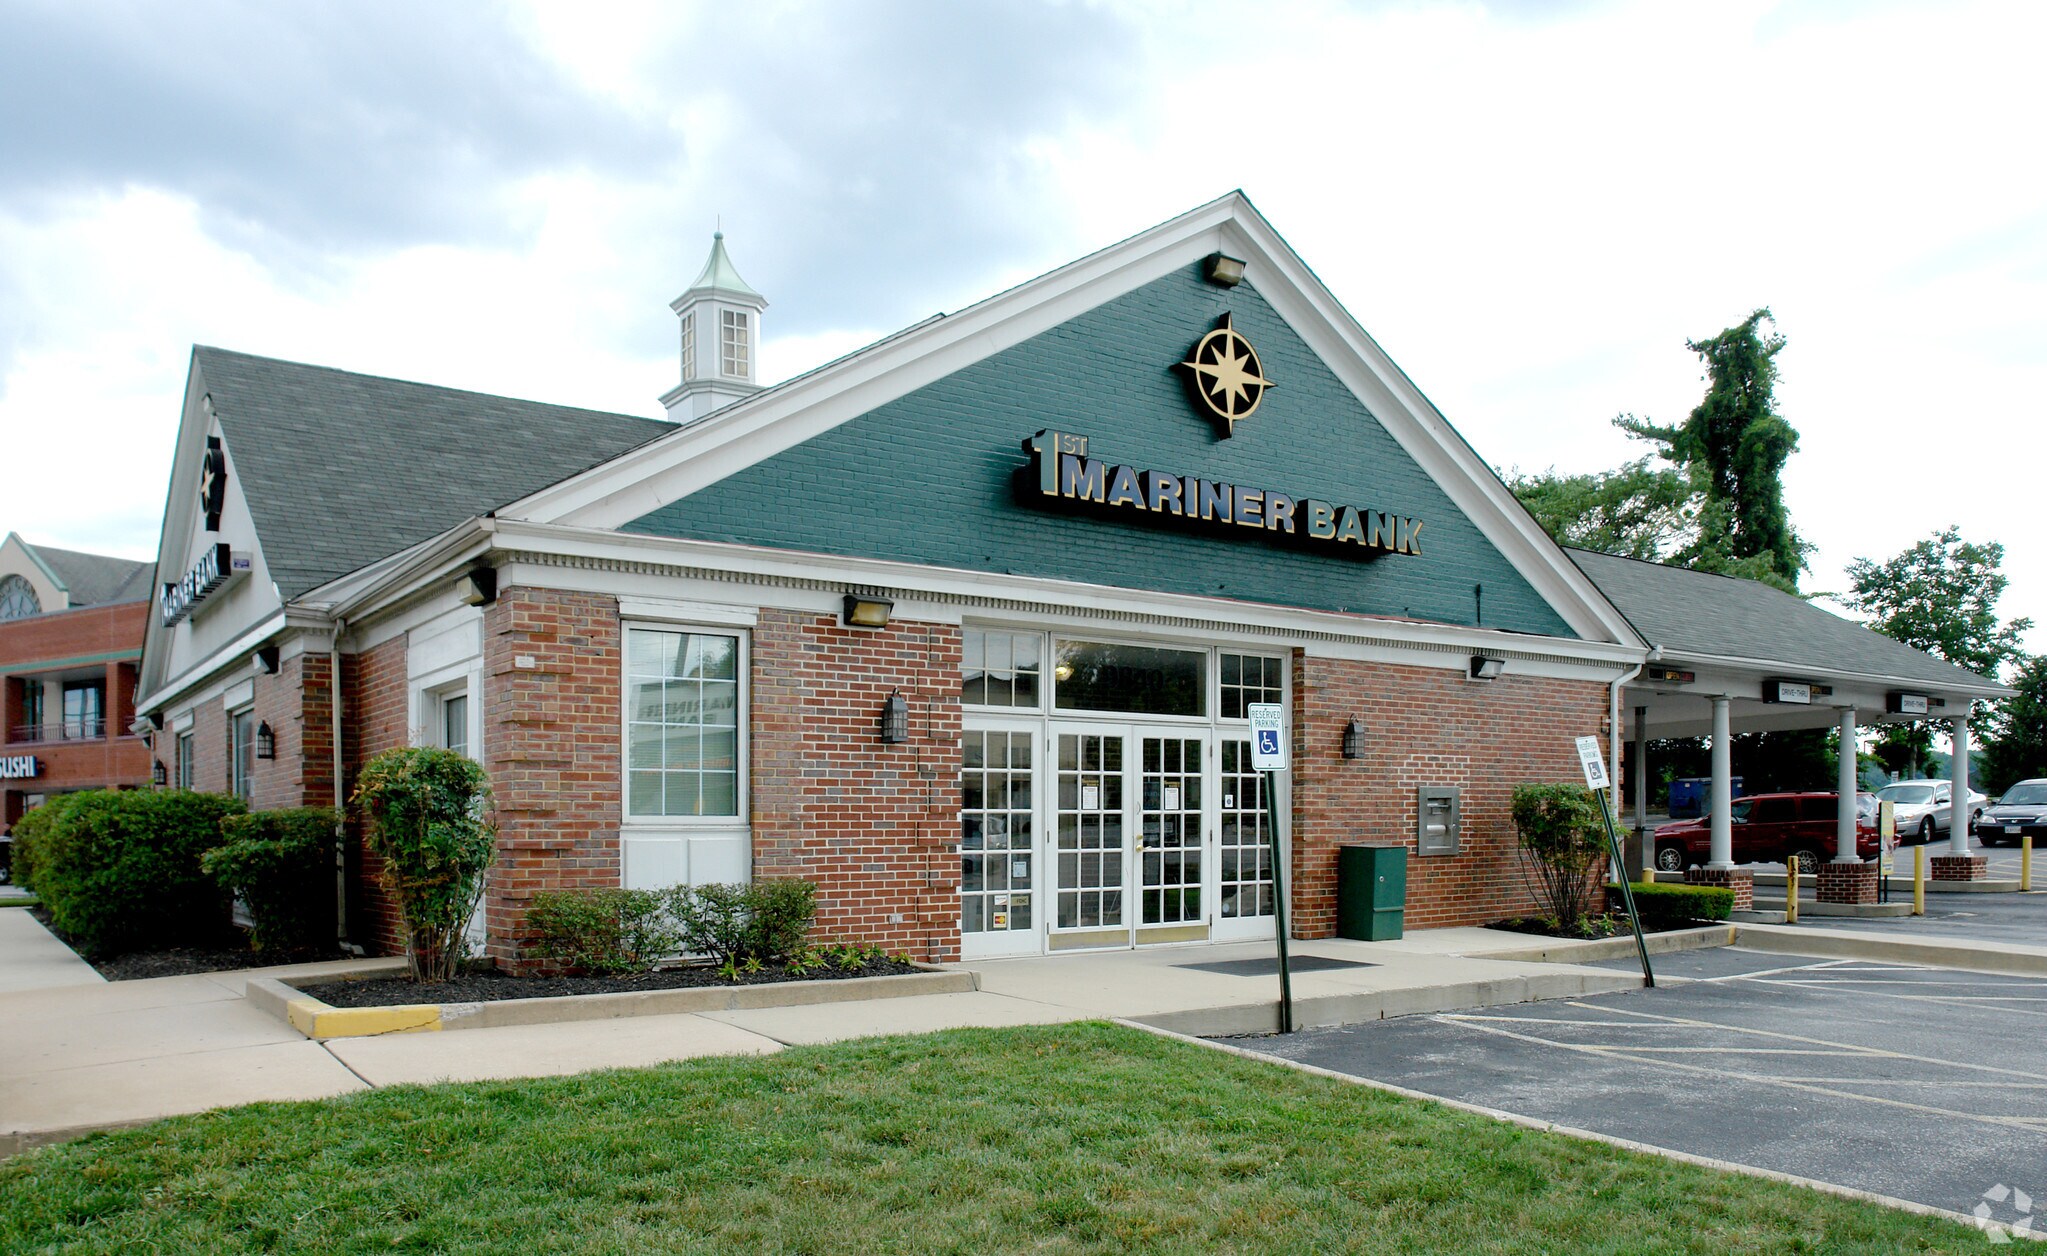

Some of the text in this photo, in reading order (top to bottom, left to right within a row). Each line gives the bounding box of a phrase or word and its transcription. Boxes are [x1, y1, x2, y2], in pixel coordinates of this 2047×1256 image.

[1062, 453, 1424, 555] MARINER BANK
[195, 543, 220, 595] BANK
[1781, 687, 1808, 698] DRIVE-THRU
[1251, 710, 1281, 720] RESERVED
[1255, 720, 1279, 728] PARKING
[0, 756, 35, 778] USHI
